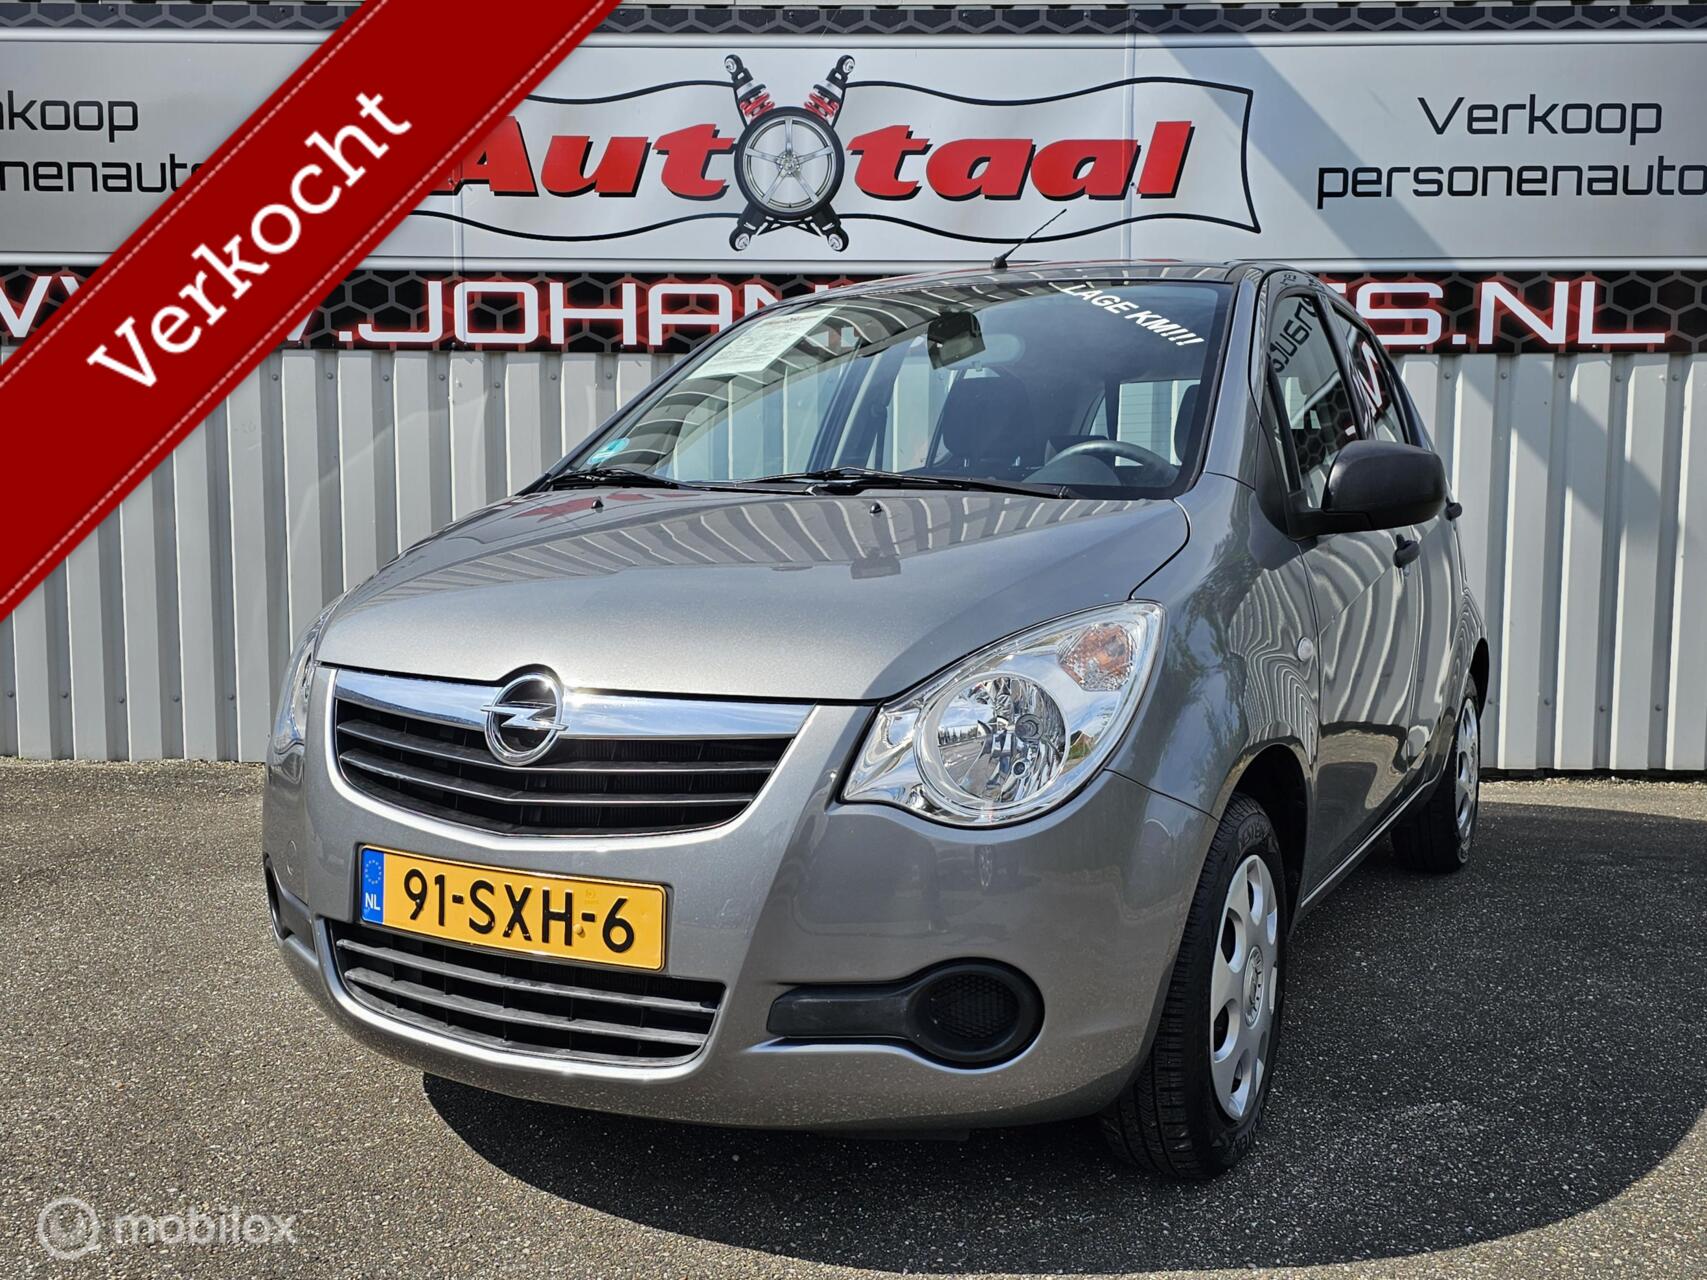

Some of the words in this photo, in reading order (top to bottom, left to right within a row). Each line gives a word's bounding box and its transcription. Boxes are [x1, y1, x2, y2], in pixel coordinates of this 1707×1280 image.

[1418, 94, 1663, 145] Verkoop
[0, 153, 205, 192] nenaut
[1317, 155, 1707, 209] personenauto
[1060, 284, 1139, 314] LAGE
[1124, 310, 1205, 346] KM!!!
[364, 891, 381, 911] NL
[403, 868, 635, 953] 91-SXH-6
